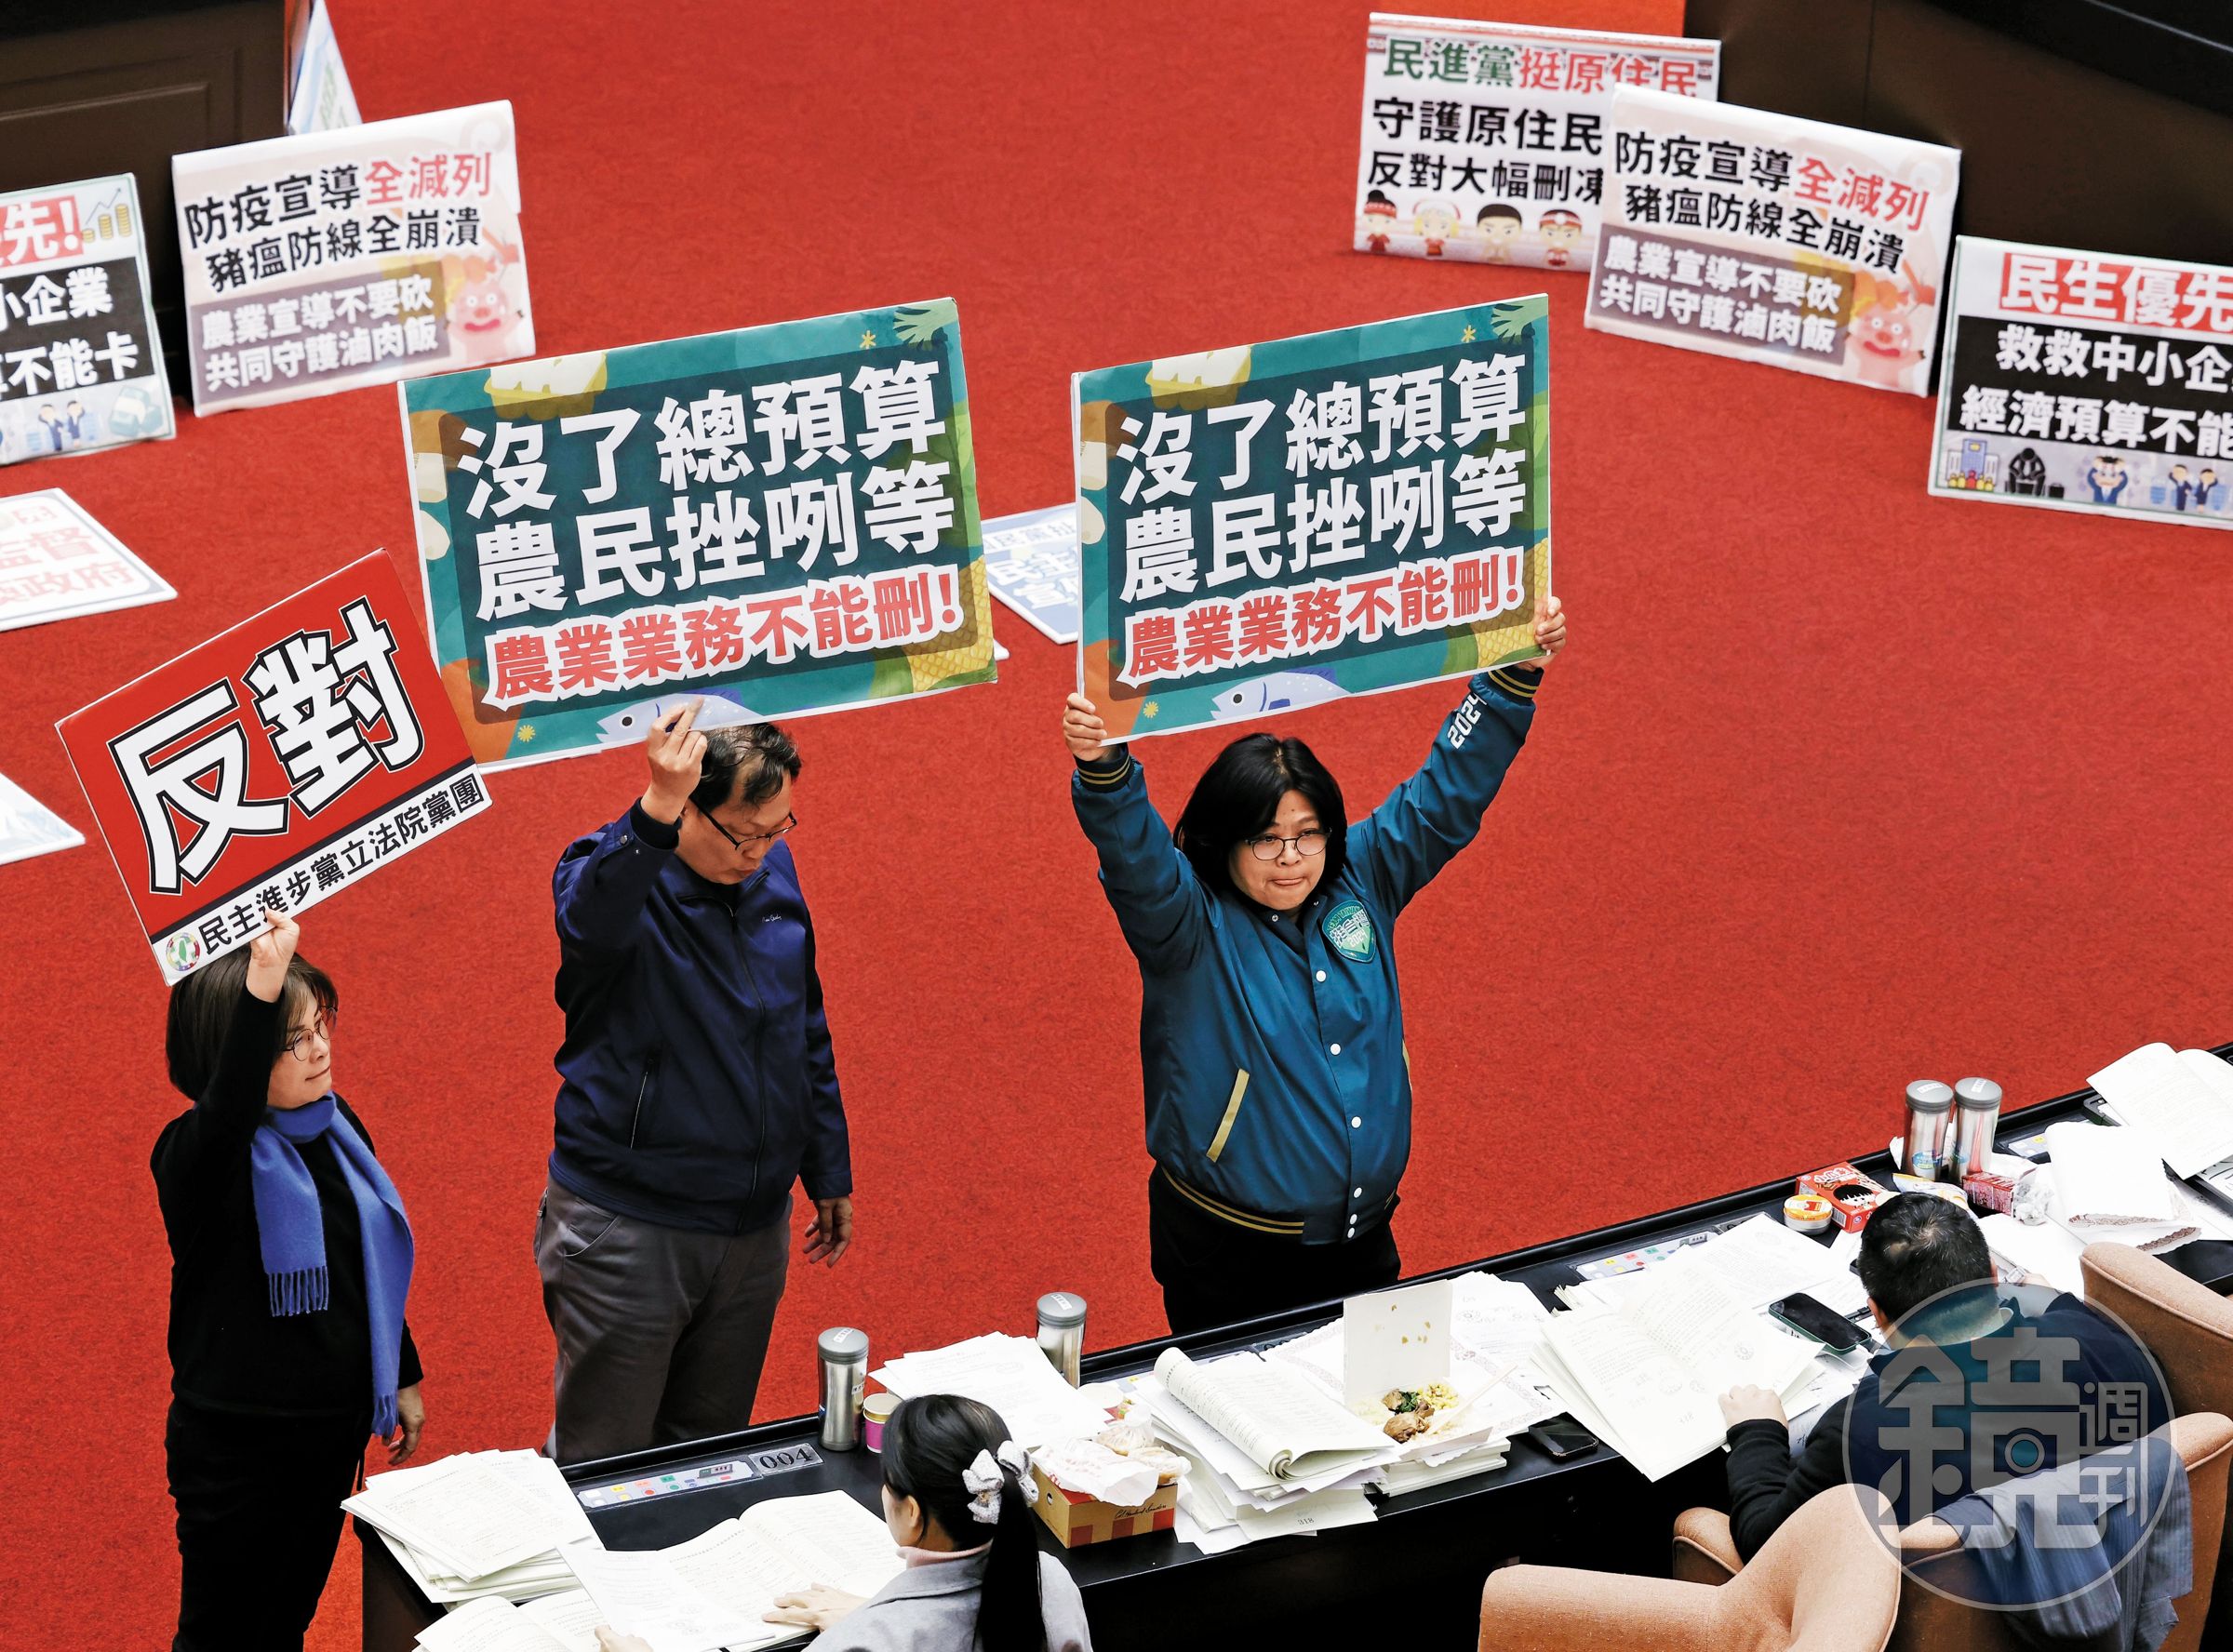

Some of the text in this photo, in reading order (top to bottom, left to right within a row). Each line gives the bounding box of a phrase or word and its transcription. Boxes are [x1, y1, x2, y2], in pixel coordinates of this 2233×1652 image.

[1383, 37, 1697, 97] 民進黨挺原住民
[1372, 97, 1603, 155] 守護原住民
[184, 152, 491, 249] 防疫宣導全減列
[1615, 131, 1930, 232] 防疫宣導全減列
[0, 200, 78, 266] 先!
[205, 208, 481, 294] 豬瘟防線全崩潰
[1625, 184, 1904, 274] 豬瘟防線全崩潰
[201, 274, 435, 352] 農業宣導不要砍
[1598, 275, 1839, 353] 共同守護滷肉飯
[1603, 234, 1843, 314] 農業宣導不要砍
[2001, 254, 2233, 332] 民生優先
[0, 331, 138, 400] 不能卡
[205, 315, 438, 393] 共同守護滷肉飯
[457, 359, 946, 520] 沒了總預算
[1116, 353, 1526, 506] 沒了總預算
[1959, 384, 2233, 460] 經濟預算不能
[475, 460, 956, 622] 農民挫咧等
[1119, 448, 1526, 605] 農民挫咧等
[492, 571, 958, 702] 農業業務不能刪!
[1128, 553, 1520, 681] 農業業務不能刪!
[107, 596, 423, 895] 反對
[1447, 693, 1488, 749] 2024
[198, 773, 485, 955] 民主進步黨立法院黨團
[759, 1446, 814, 1471] 004
